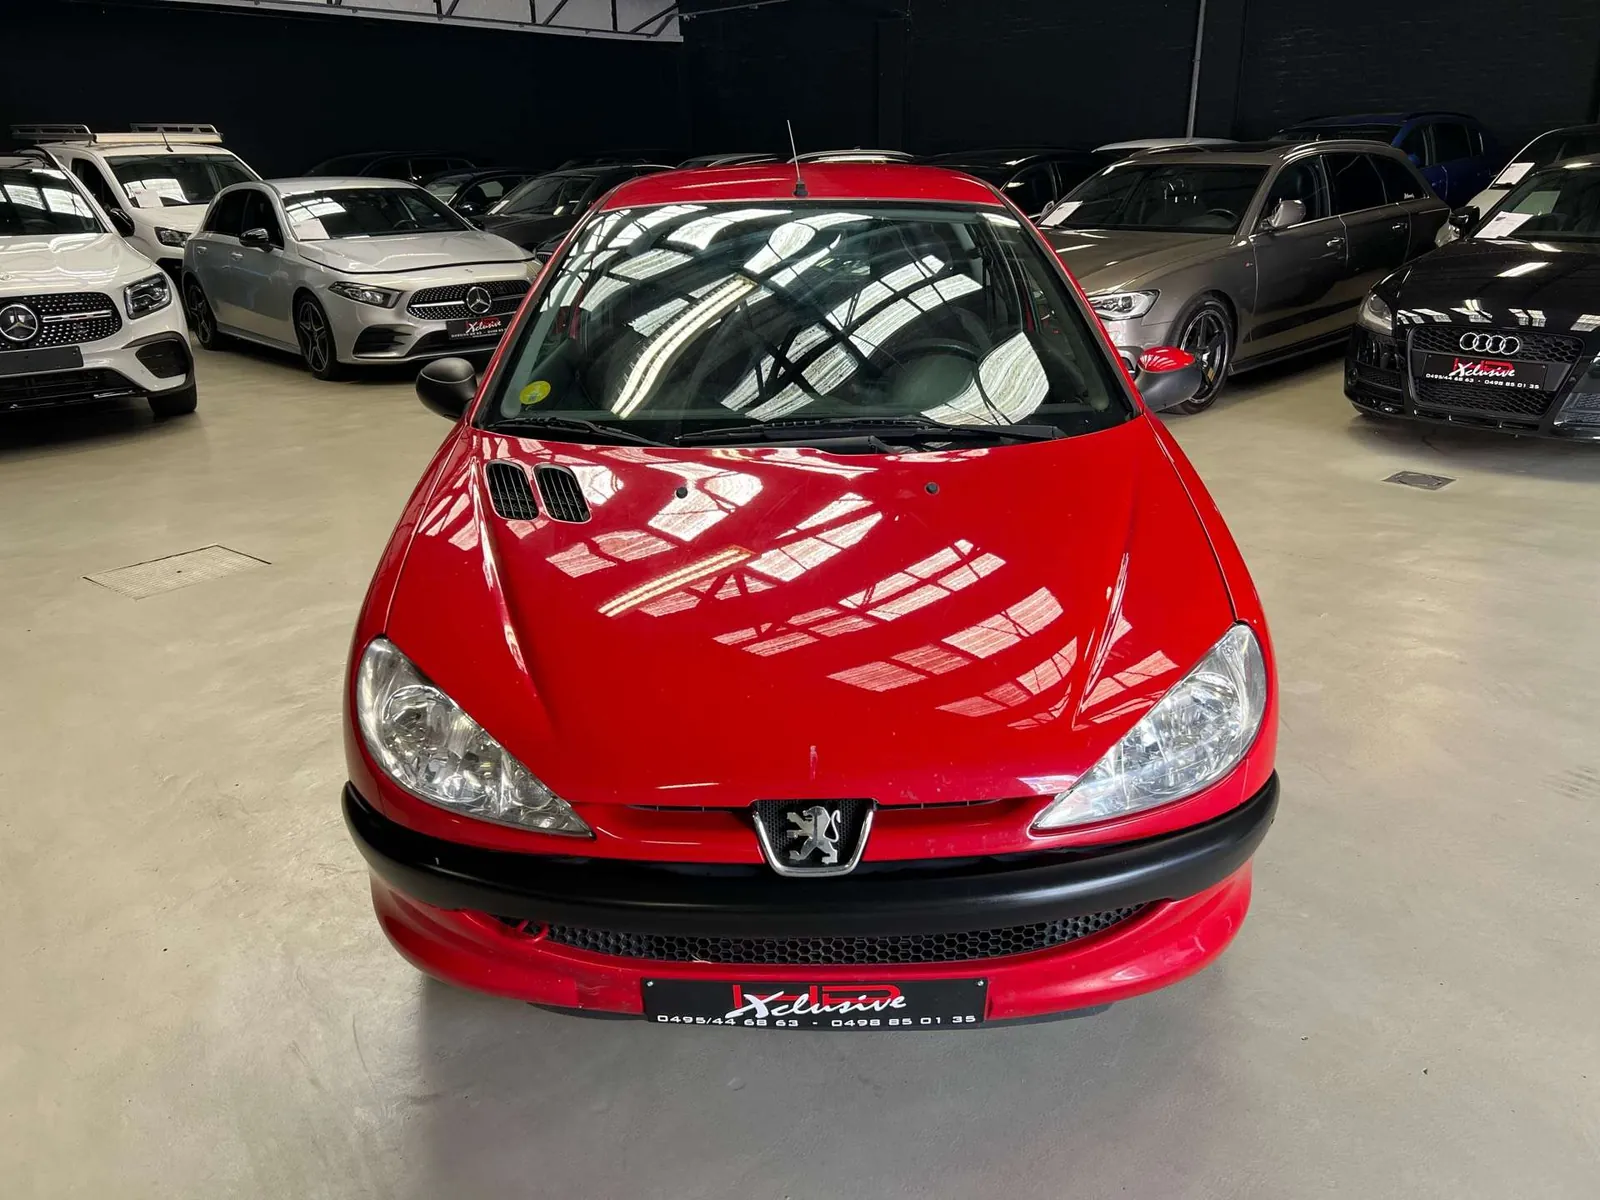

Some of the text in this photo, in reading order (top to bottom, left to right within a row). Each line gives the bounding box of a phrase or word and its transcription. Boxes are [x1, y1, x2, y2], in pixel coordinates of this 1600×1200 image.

[1448, 361, 1516, 378] Xclusive
[724, 990, 907, 1019] Xclusive
[656, 1014, 737, 1026] 0495/44
[743, 1018, 768, 1027] 68
[775, 1018, 799, 1027] 63
[831, 1018, 881, 1028] 0498
[888, 1017, 913, 1026] 85
[920, 1016, 941, 1025] 01
[952, 1014, 976, 1024] 35
